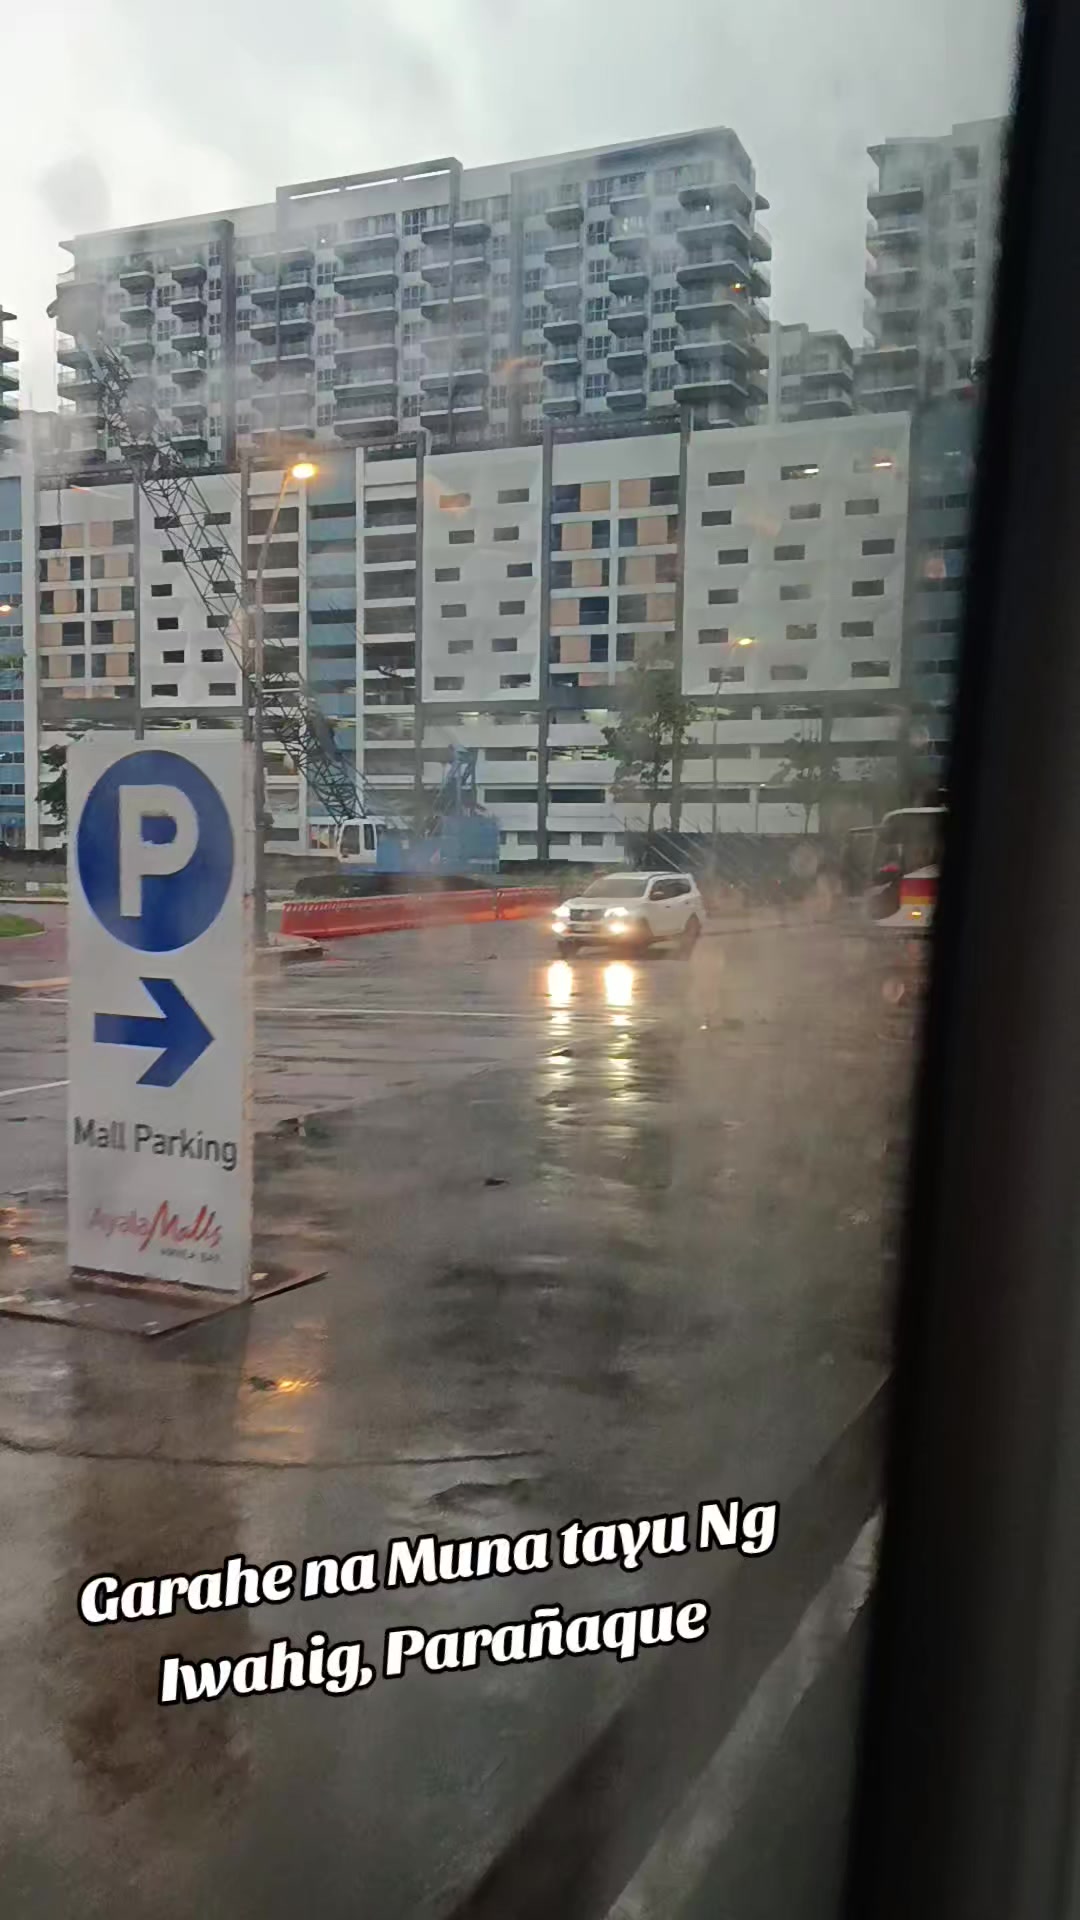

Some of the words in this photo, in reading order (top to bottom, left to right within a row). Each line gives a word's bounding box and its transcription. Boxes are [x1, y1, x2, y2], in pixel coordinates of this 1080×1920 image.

[119, 784, 199, 917] P
[73, 1116, 126, 1151] Mall
[134, 1123, 238, 1171] Parking
